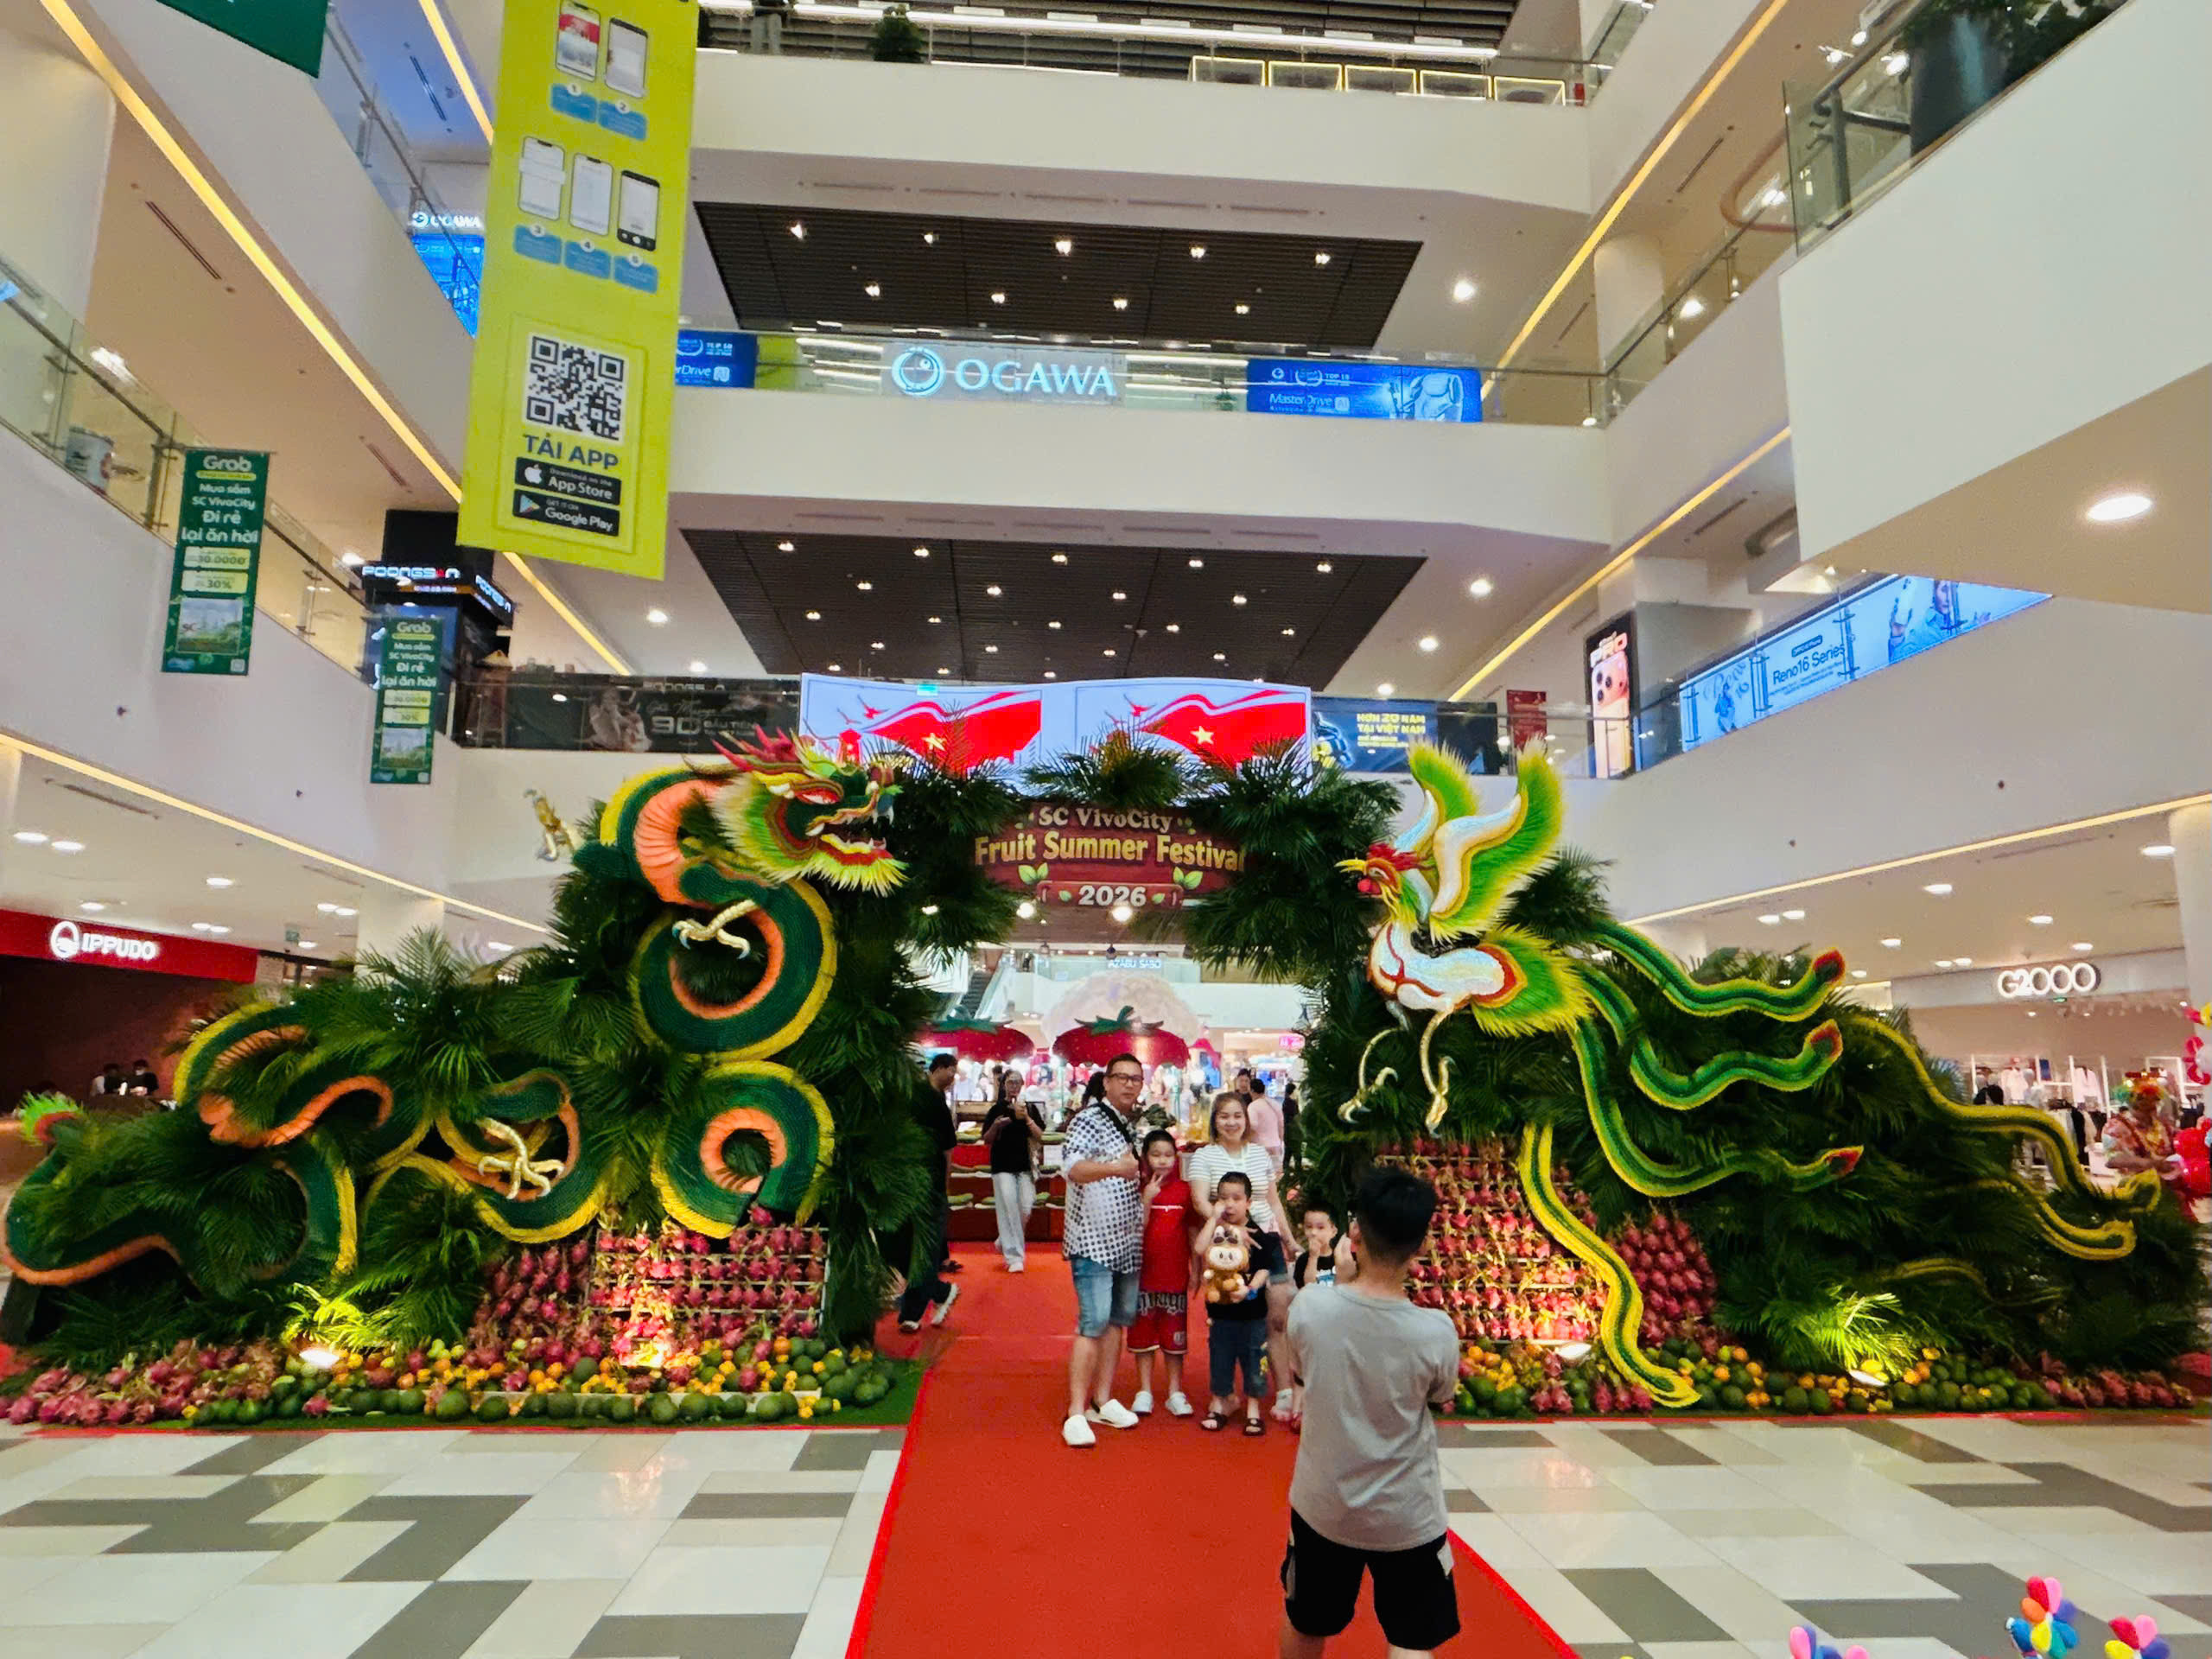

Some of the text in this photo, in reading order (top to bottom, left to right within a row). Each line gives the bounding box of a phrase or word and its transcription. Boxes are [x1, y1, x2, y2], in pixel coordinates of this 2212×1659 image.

[955, 359, 1116, 397] OGAWA
[203, 455, 251, 472] Grab
[523, 433, 619, 469] TẢI APP
[549, 476, 613, 499] App Store
[545, 507, 613, 531] Google Play
[397, 621, 431, 633] Grab
[1039, 807, 1173, 833] SC VivoCity
[975, 830, 1247, 872] Fruit Summer Festival
[1078, 886, 1147, 906] 2026
[81, 932, 159, 961] IPPUDO
[1997, 963, 2097, 998] G2000
